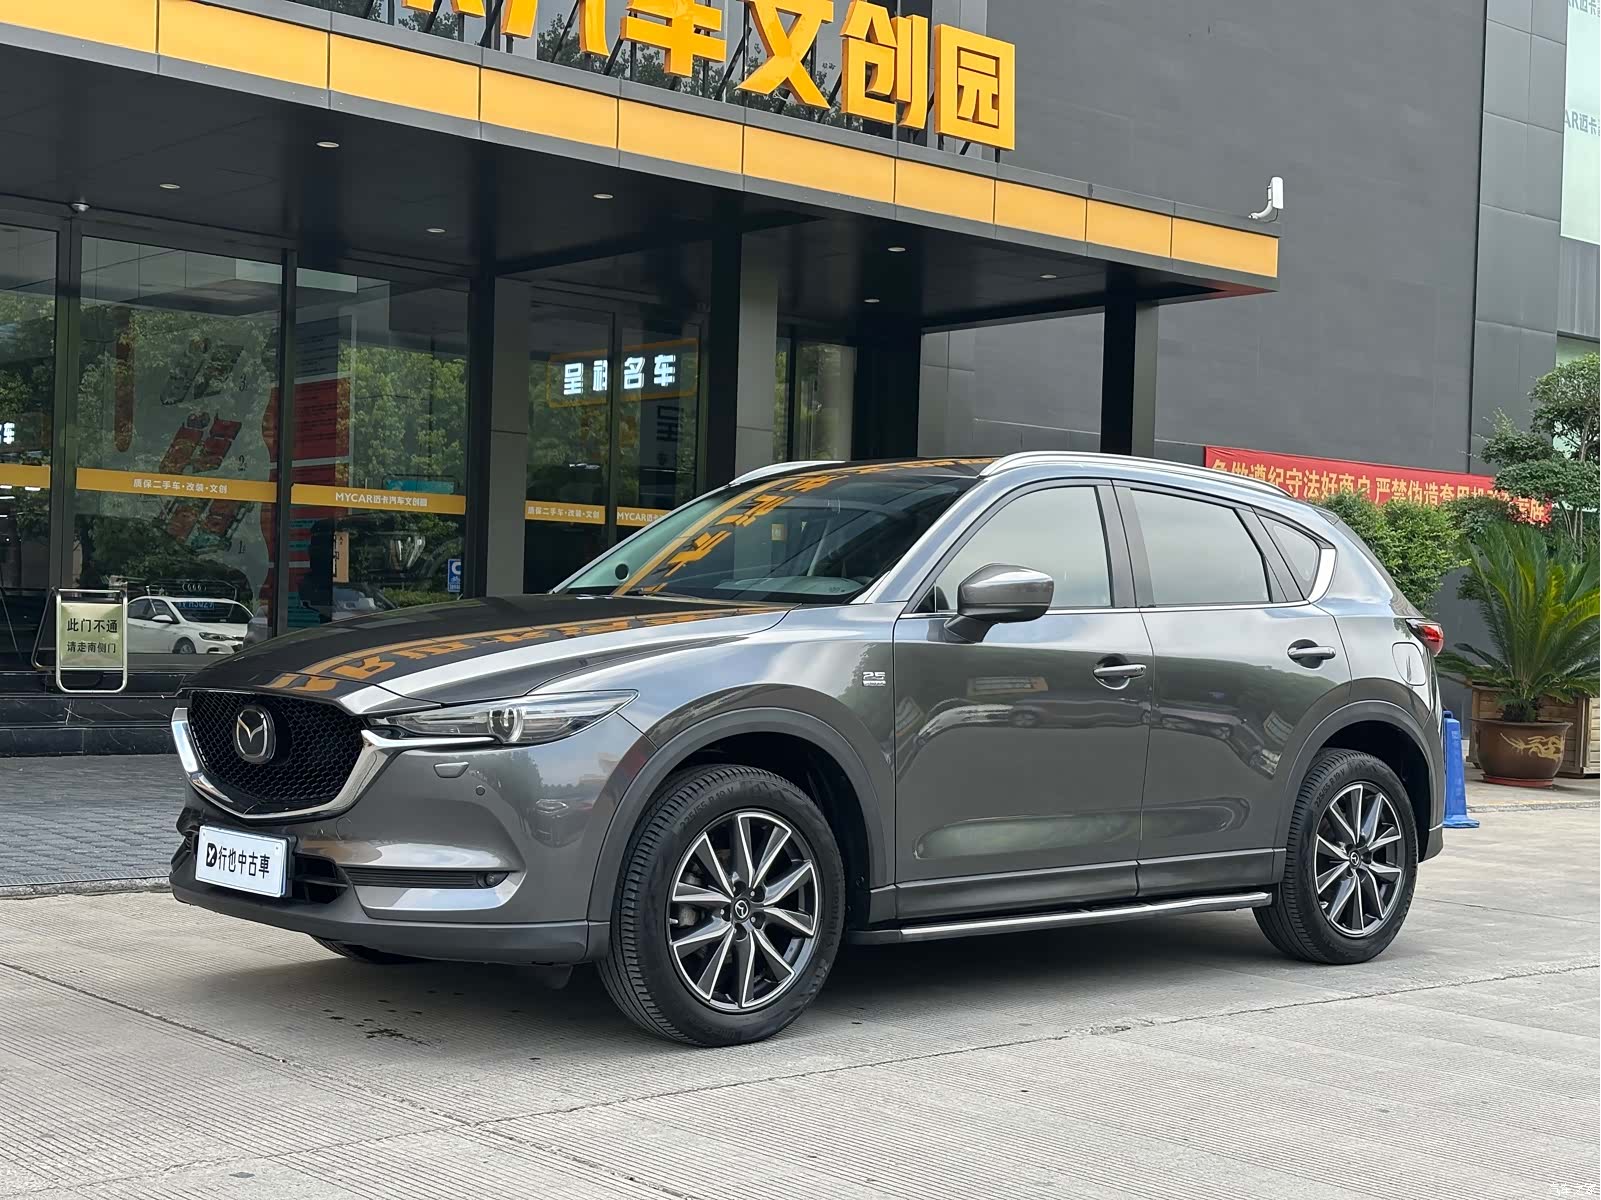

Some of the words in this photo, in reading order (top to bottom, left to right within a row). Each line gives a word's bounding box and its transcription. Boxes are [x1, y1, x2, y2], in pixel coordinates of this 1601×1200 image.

[401, 0, 1015, 150] 车文创园
[67, 618, 118, 633] 此门不通
[67, 641, 116, 653] 请走南侧门
